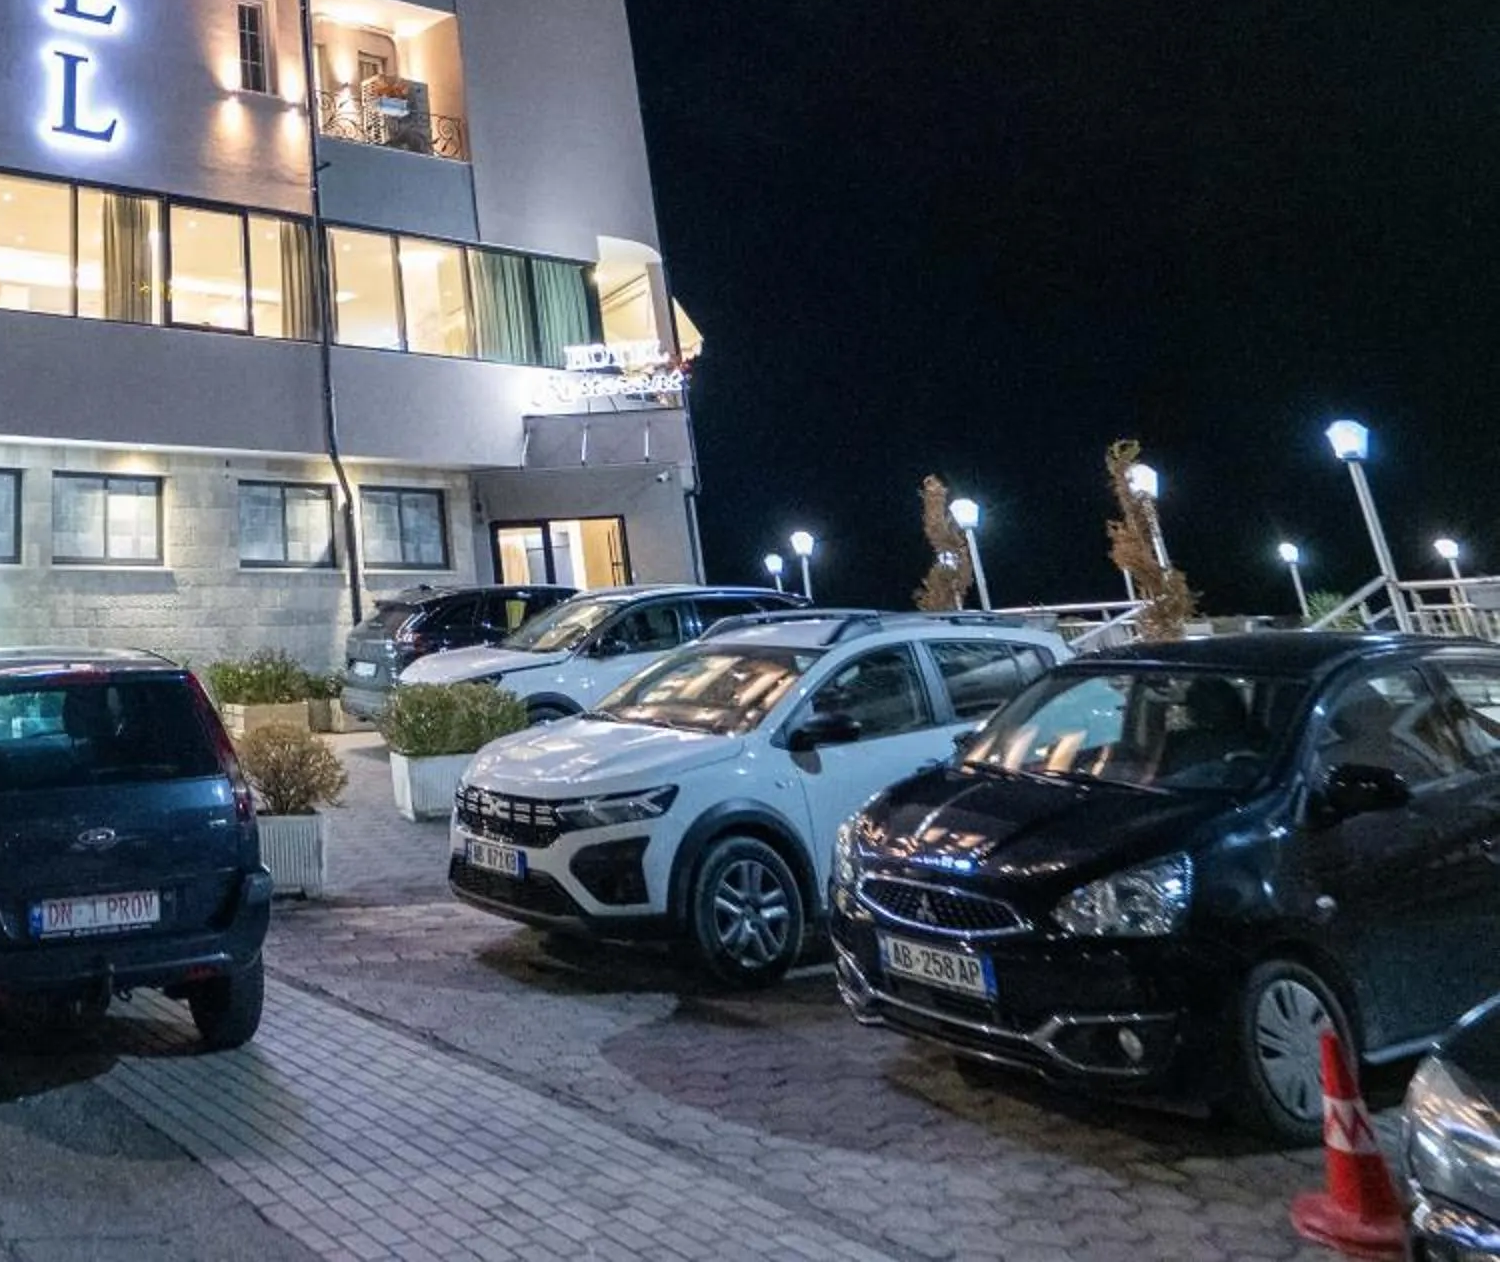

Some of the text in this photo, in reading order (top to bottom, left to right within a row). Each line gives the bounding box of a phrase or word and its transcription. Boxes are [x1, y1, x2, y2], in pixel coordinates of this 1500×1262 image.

[106, 892, 154, 922] PROV
[892, 941, 980, 987] AB 258 AP
